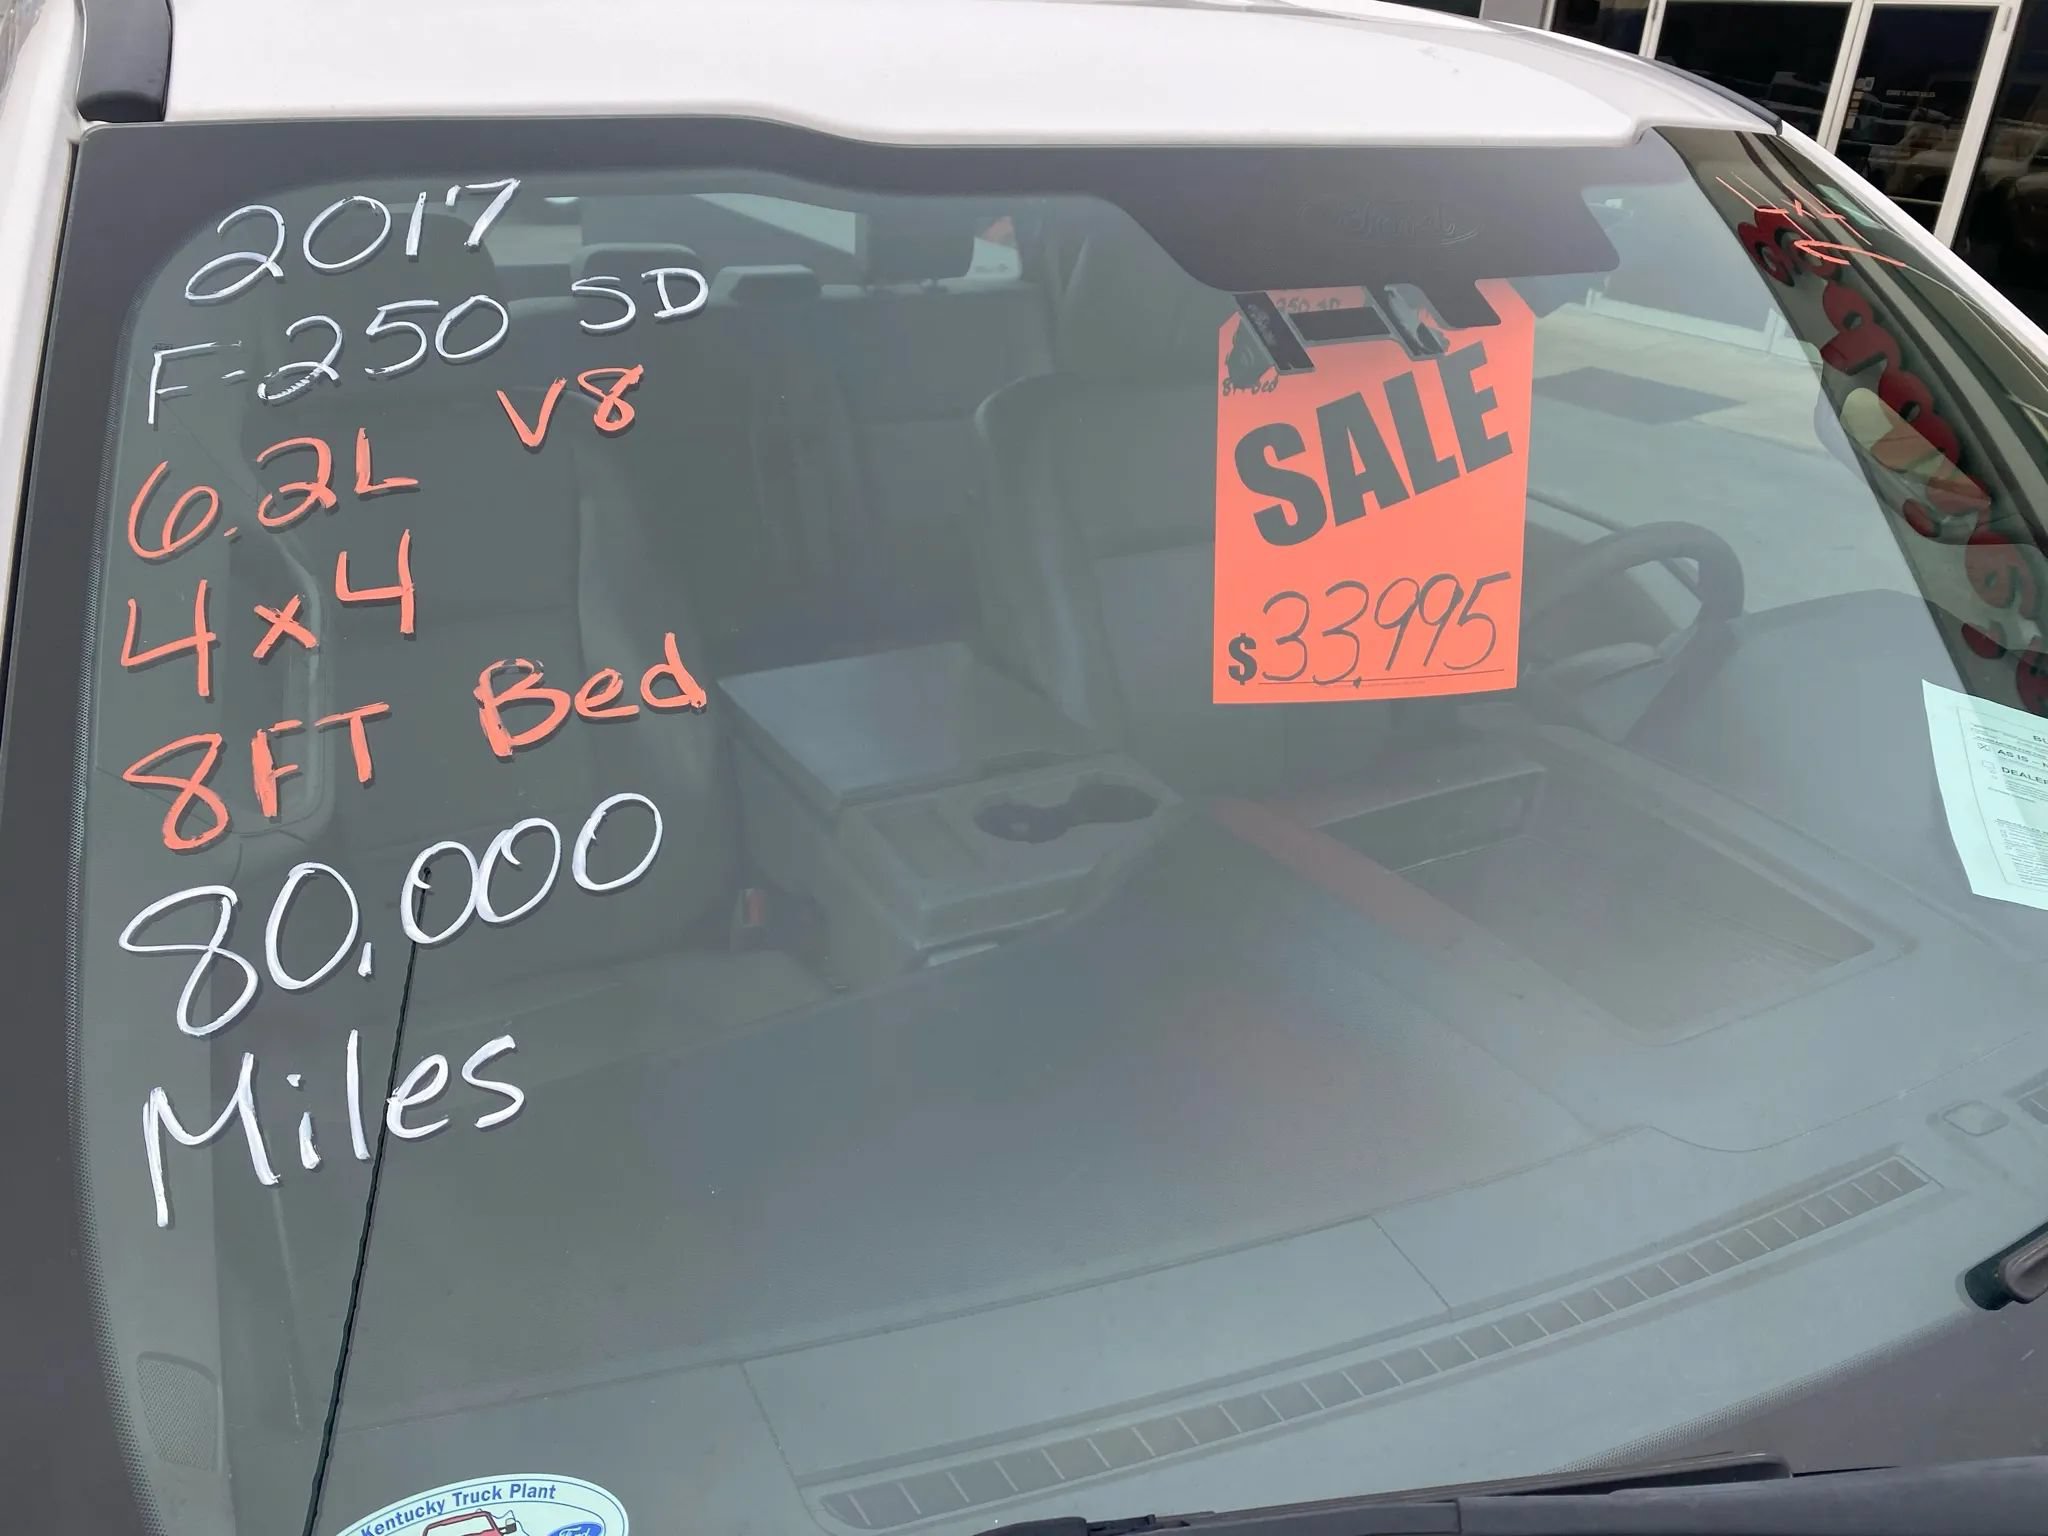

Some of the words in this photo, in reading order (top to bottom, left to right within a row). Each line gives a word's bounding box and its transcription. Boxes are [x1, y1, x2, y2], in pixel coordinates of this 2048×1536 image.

[184, 178, 520, 300] 2017
[149, 294, 508, 423] F-250
[571, 268, 709, 330] SD
[127, 427, 418, 560] 6.2L
[497, 364, 643, 447] V8
[1234, 341, 1512, 547] SALE
[474, 633, 707, 757] Bed
[143, 1030, 524, 1228] Miles
[361, 1496, 447, 1536] Kentucky
[451, 1485, 503, 1508] Truck
[509, 1483, 556, 1500] Plant
